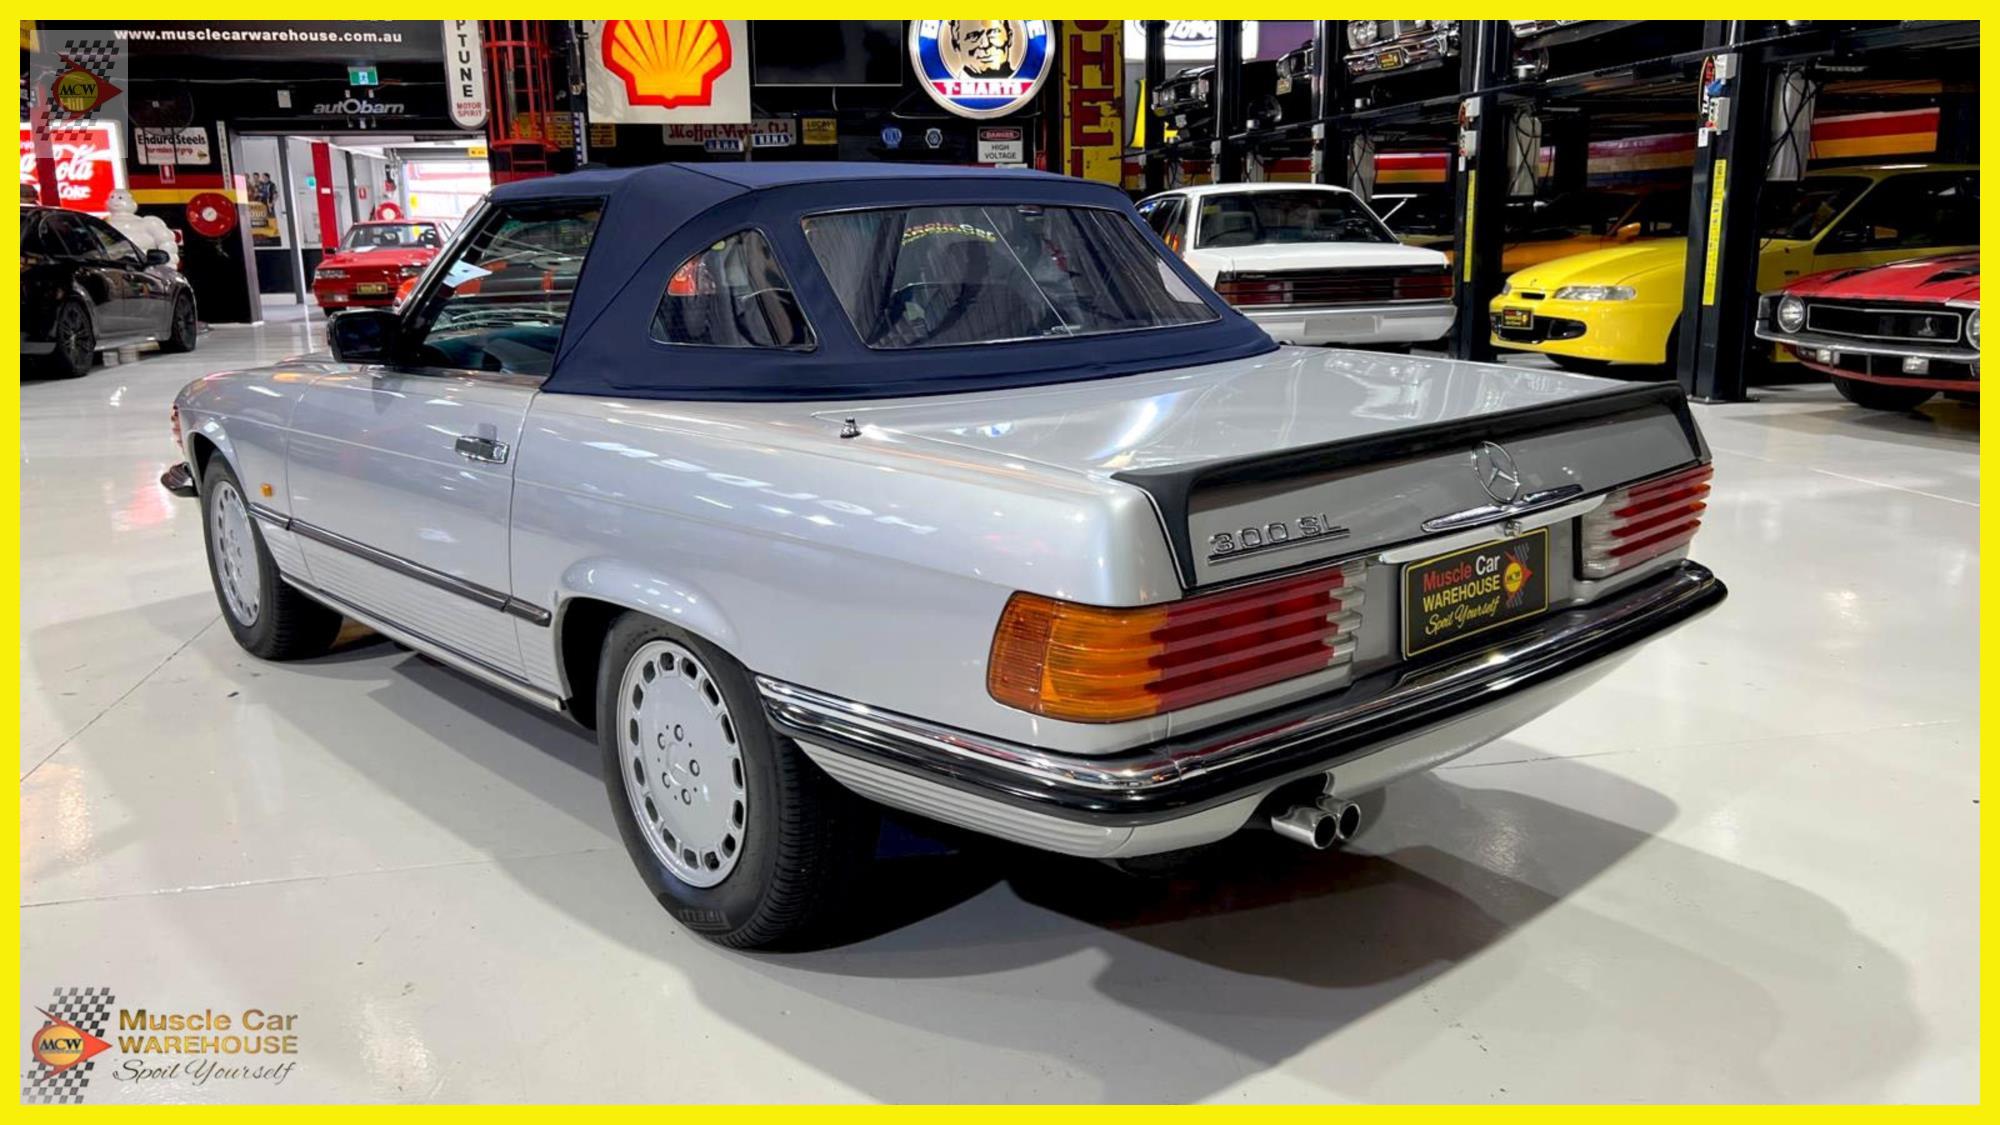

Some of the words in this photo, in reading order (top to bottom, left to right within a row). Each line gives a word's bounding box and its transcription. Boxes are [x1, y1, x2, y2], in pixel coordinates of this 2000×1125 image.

[114, 28, 402, 43] www.musclecarwarehouse.com.au
[943, 82, 1022, 95] T-MARTS
[313, 99, 405, 115] autObarn
[456, 102, 482, 110] MOTOR
[457, 110, 482, 118] SPIRIT
[175, 134, 206, 145] Steels
[984, 151, 1017, 159] VOLTAGE
[1208, 522, 1289, 555] 300
[1296, 513, 1342, 536] SL
[1423, 561, 1473, 593] Muscle
[1475, 555, 1501, 576] Car
[1423, 574, 1501, 613] WAREHOUSE
[1425, 612, 1454, 635] Spoil
[1454, 595, 1501, 629] Yourself
